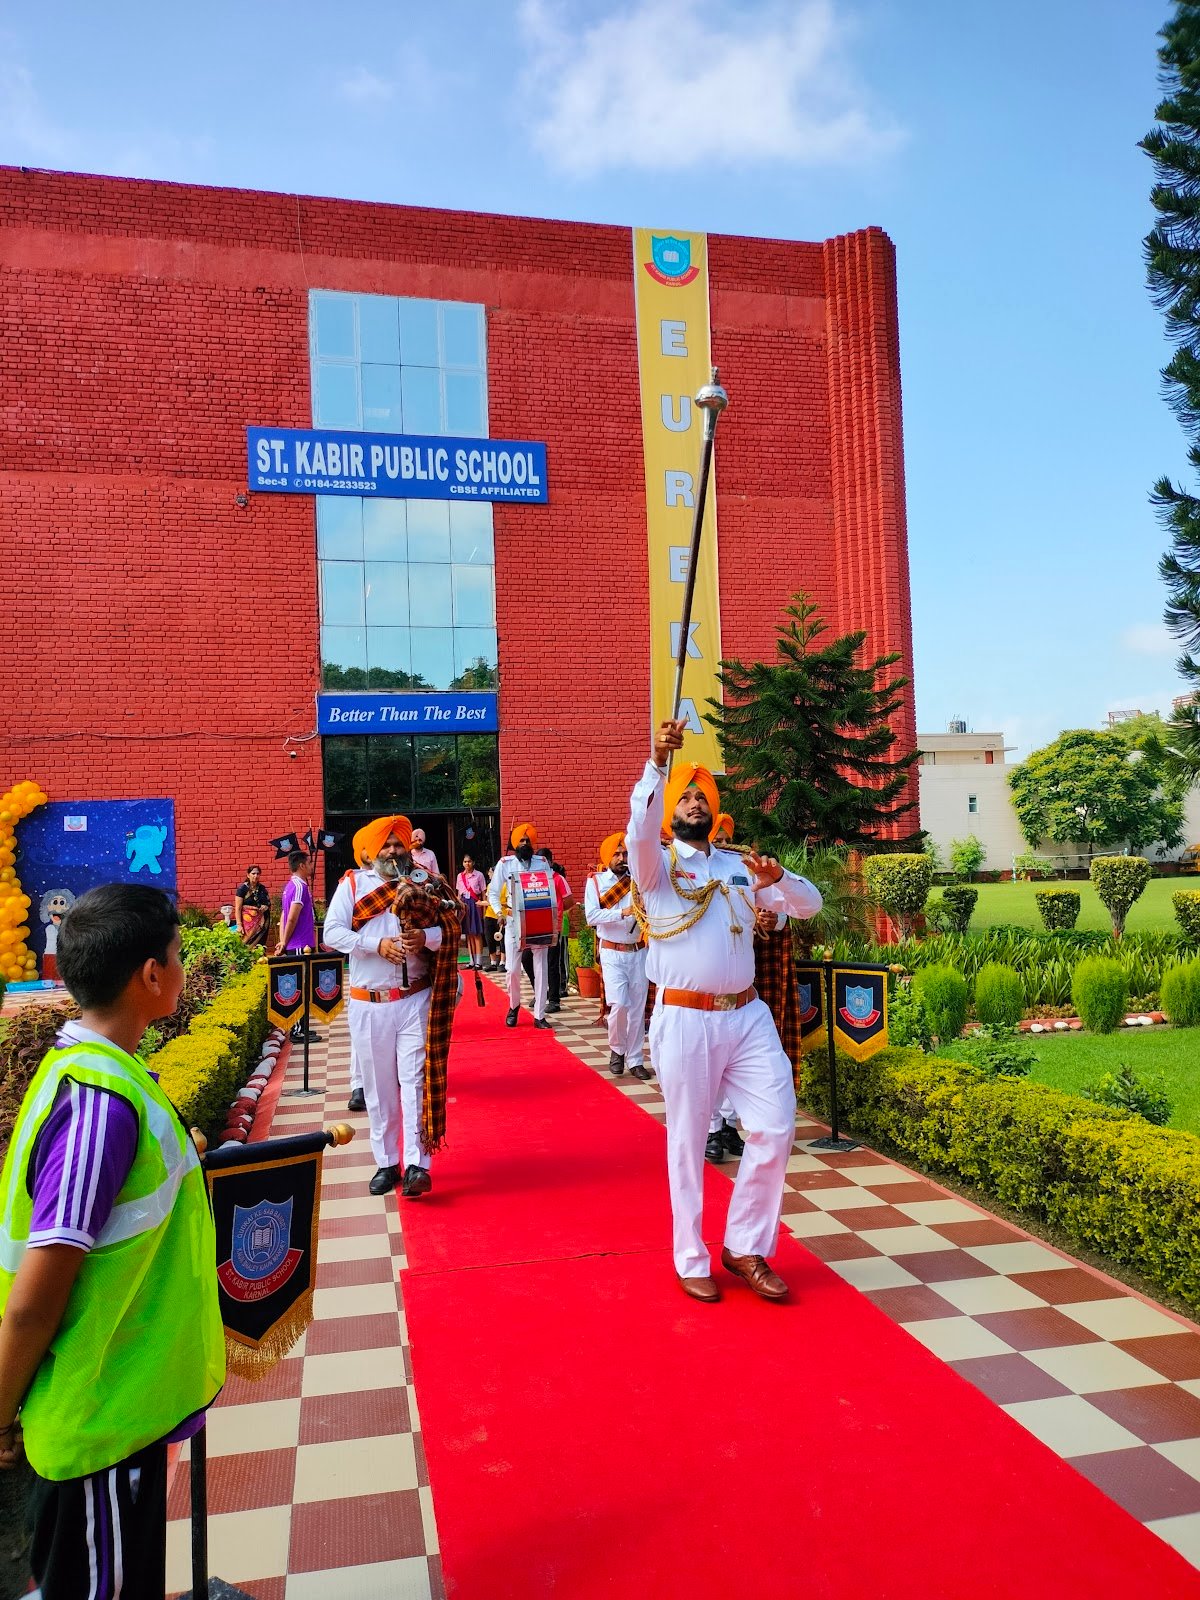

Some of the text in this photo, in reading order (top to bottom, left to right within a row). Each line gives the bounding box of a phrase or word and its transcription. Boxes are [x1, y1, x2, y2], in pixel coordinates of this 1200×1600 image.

[256, 438, 540, 485] ST. KABIR PUBLIC SCHOOL
[257, 476, 377, 491] Sec-8 0184-2233523
[450, 485, 540, 497] CBSE AFFILIATED
[660, 320, 704, 735] EUREKA
[328, 705, 487, 723] Better Than The Best
[231, 1276, 249, 1290] KABIR
[248, 1278, 272, 1291] PUBLIC
[272, 1258, 293, 1282] SCHOOL
[243, 1288, 271, 1300] KARNAL
